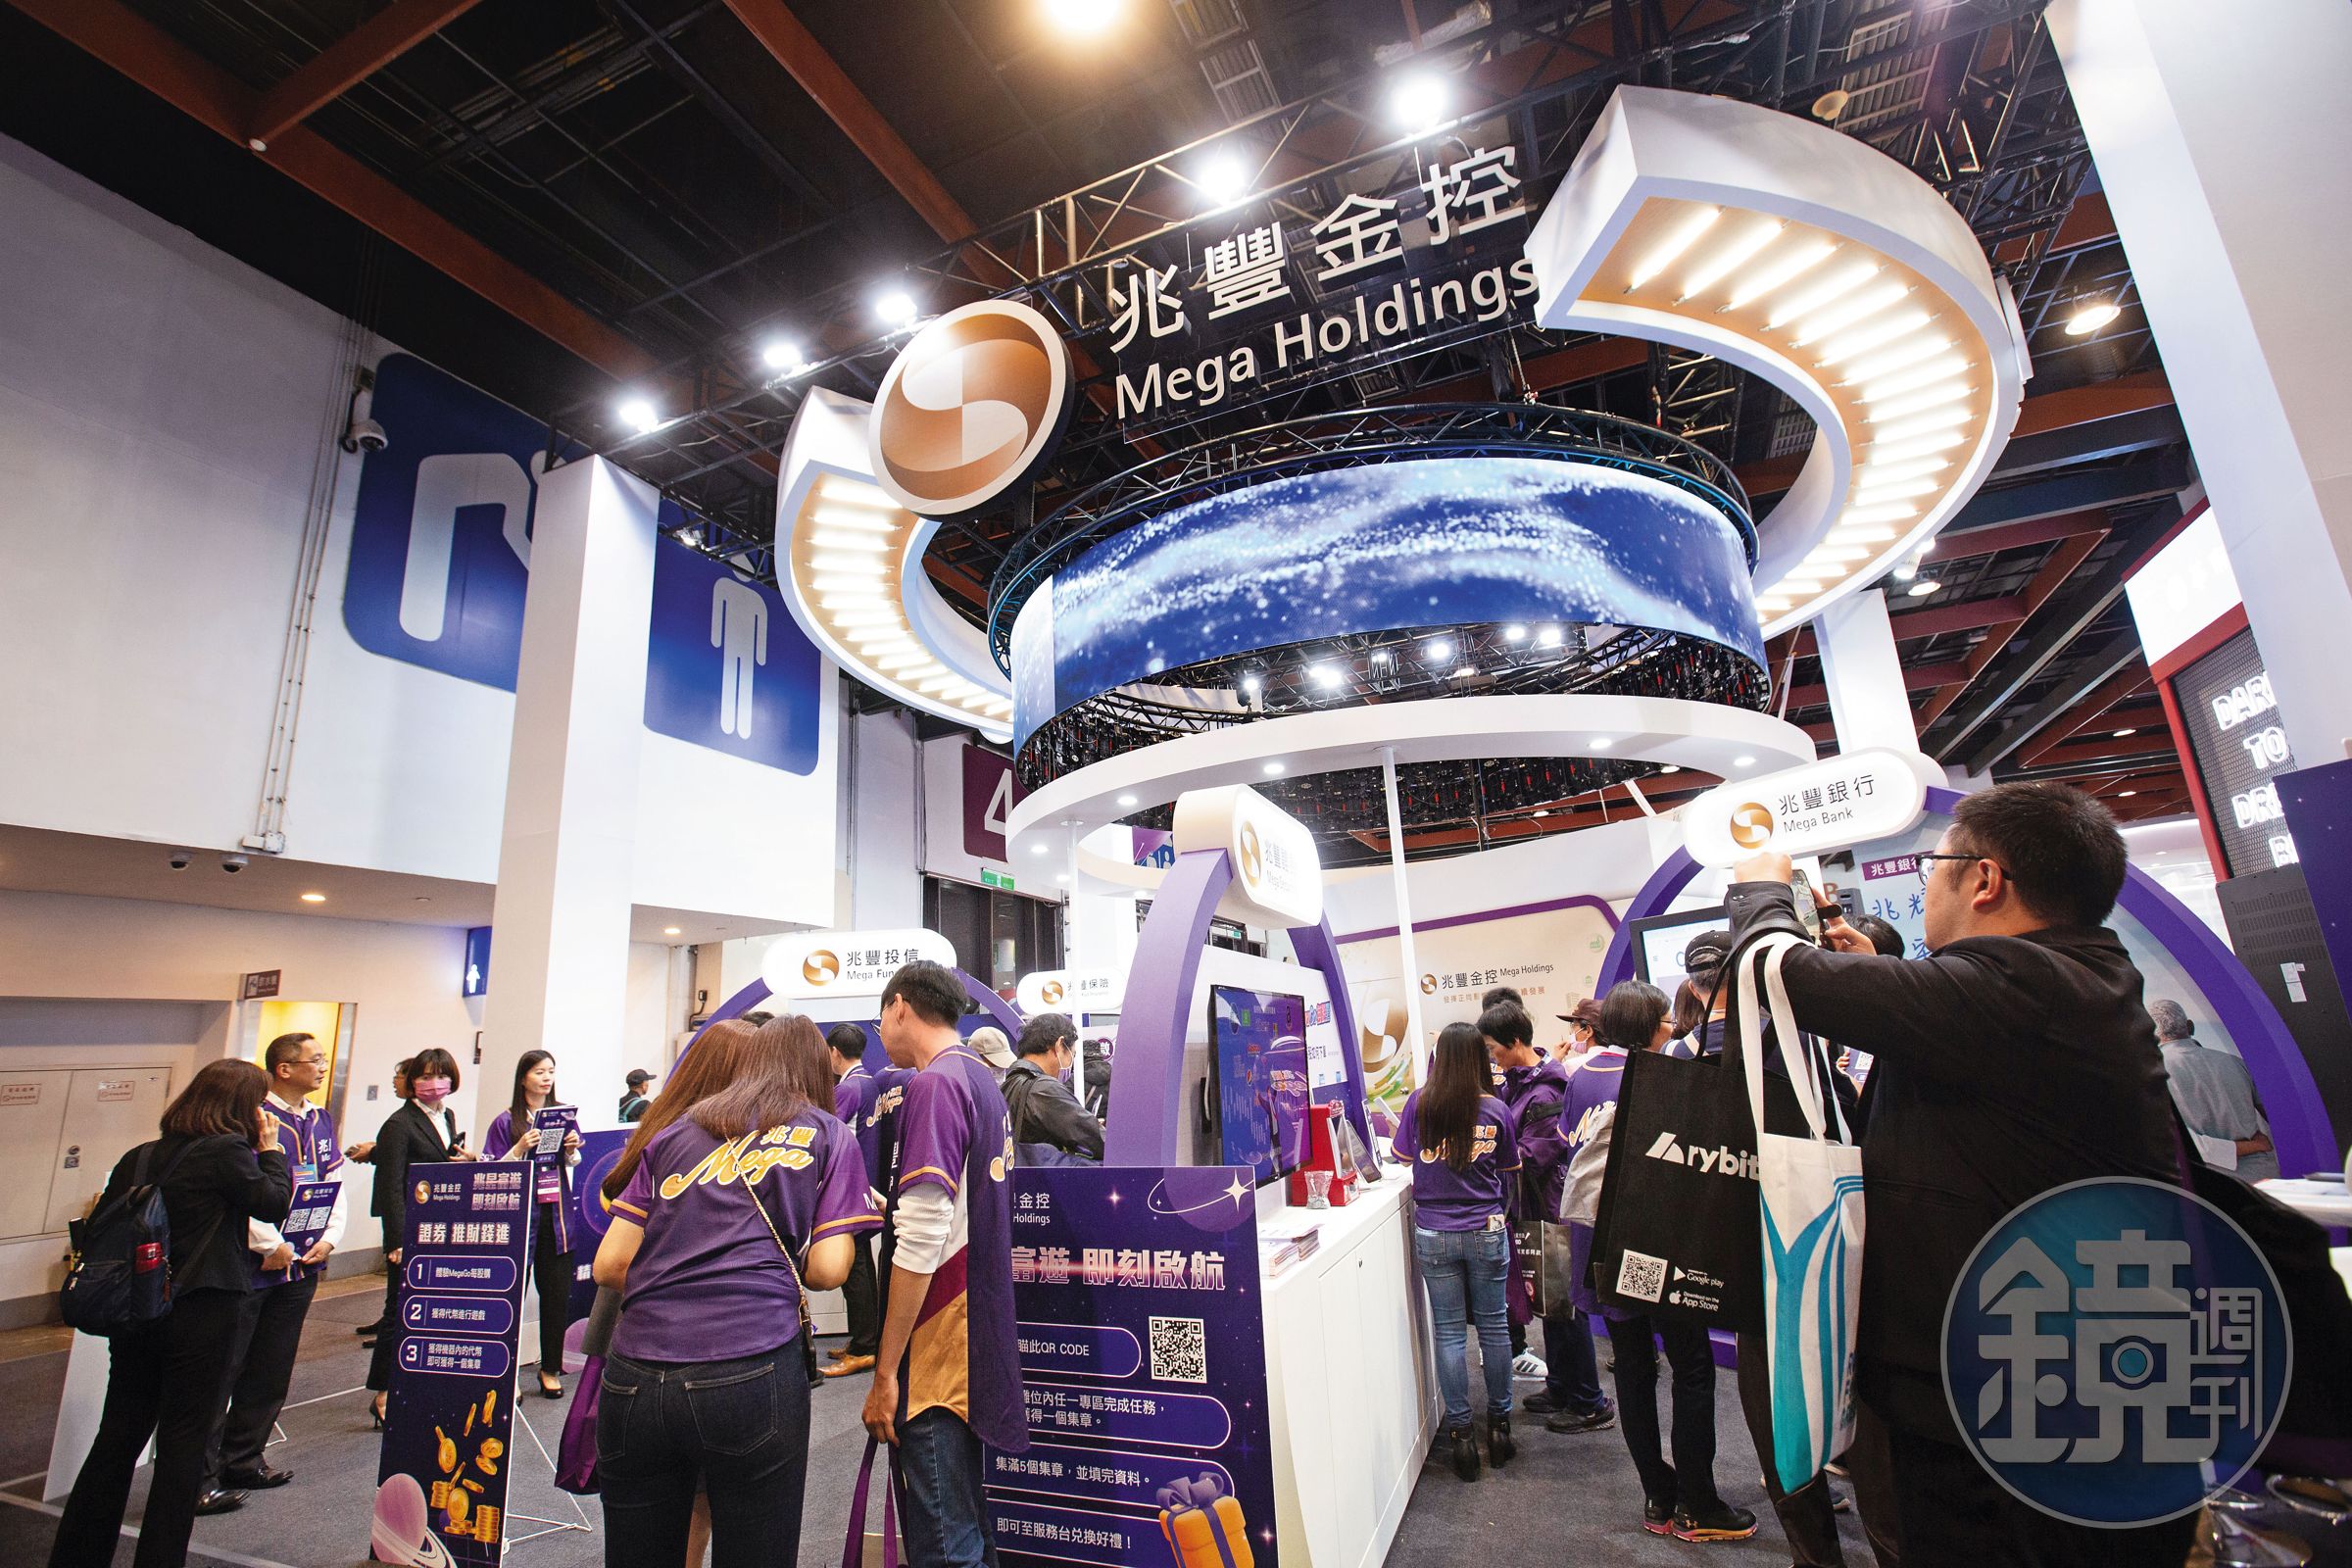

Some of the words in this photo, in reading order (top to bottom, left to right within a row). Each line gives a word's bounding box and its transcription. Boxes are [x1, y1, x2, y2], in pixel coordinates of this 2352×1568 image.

[1108, 143, 1526, 355] 兆豐金控
[1116, 346, 1255, 420] Mega
[1276, 258, 1539, 369] Holdings
[2242, 726, 2289, 769] TO
[984, 767, 1013, 836] 4
[1779, 774, 1875, 816] 兆豐銀行
[1784, 817, 1818, 833] Mega
[1822, 808, 1854, 825] Bank
[847, 948, 919, 967] 兆豐投信
[847, 970, 873, 981] Mega
[1442, 969, 1499, 990] 兆豐金控
[1500, 966, 1520, 977] Mega
[1521, 963, 1555, 974] Holdings
[760, 1125, 817, 1148] 兆豐
[660, 1129, 814, 1200] Mega
[471, 1193, 521, 1211] 即刻啟航
[1013, 1192, 1051, 1209] 金控
[1013, 1213, 1051, 1226] Holdings
[417, 1222, 447, 1245] 證券
[416, 1263, 423, 1280] 1
[1010, 1246, 1071, 1285] 富遊
[1082, 1248, 1226, 1291] 即刻啟航
[1687, 1272, 1710, 1286] Google
[1710, 1278, 1725, 1289] play
[410, 1303, 422, 1320] 2
[1682, 1297, 1698, 1308] App
[1698, 1299, 1719, 1311] Store
[406, 1345, 417, 1361] 3
[1059, 1343, 1090, 1356] CODE
[996, 1456, 1151, 1488] 集滿5個集章，並填完資料。
[997, 1517, 1131, 1549] 即可至服務台兌換好禮！
